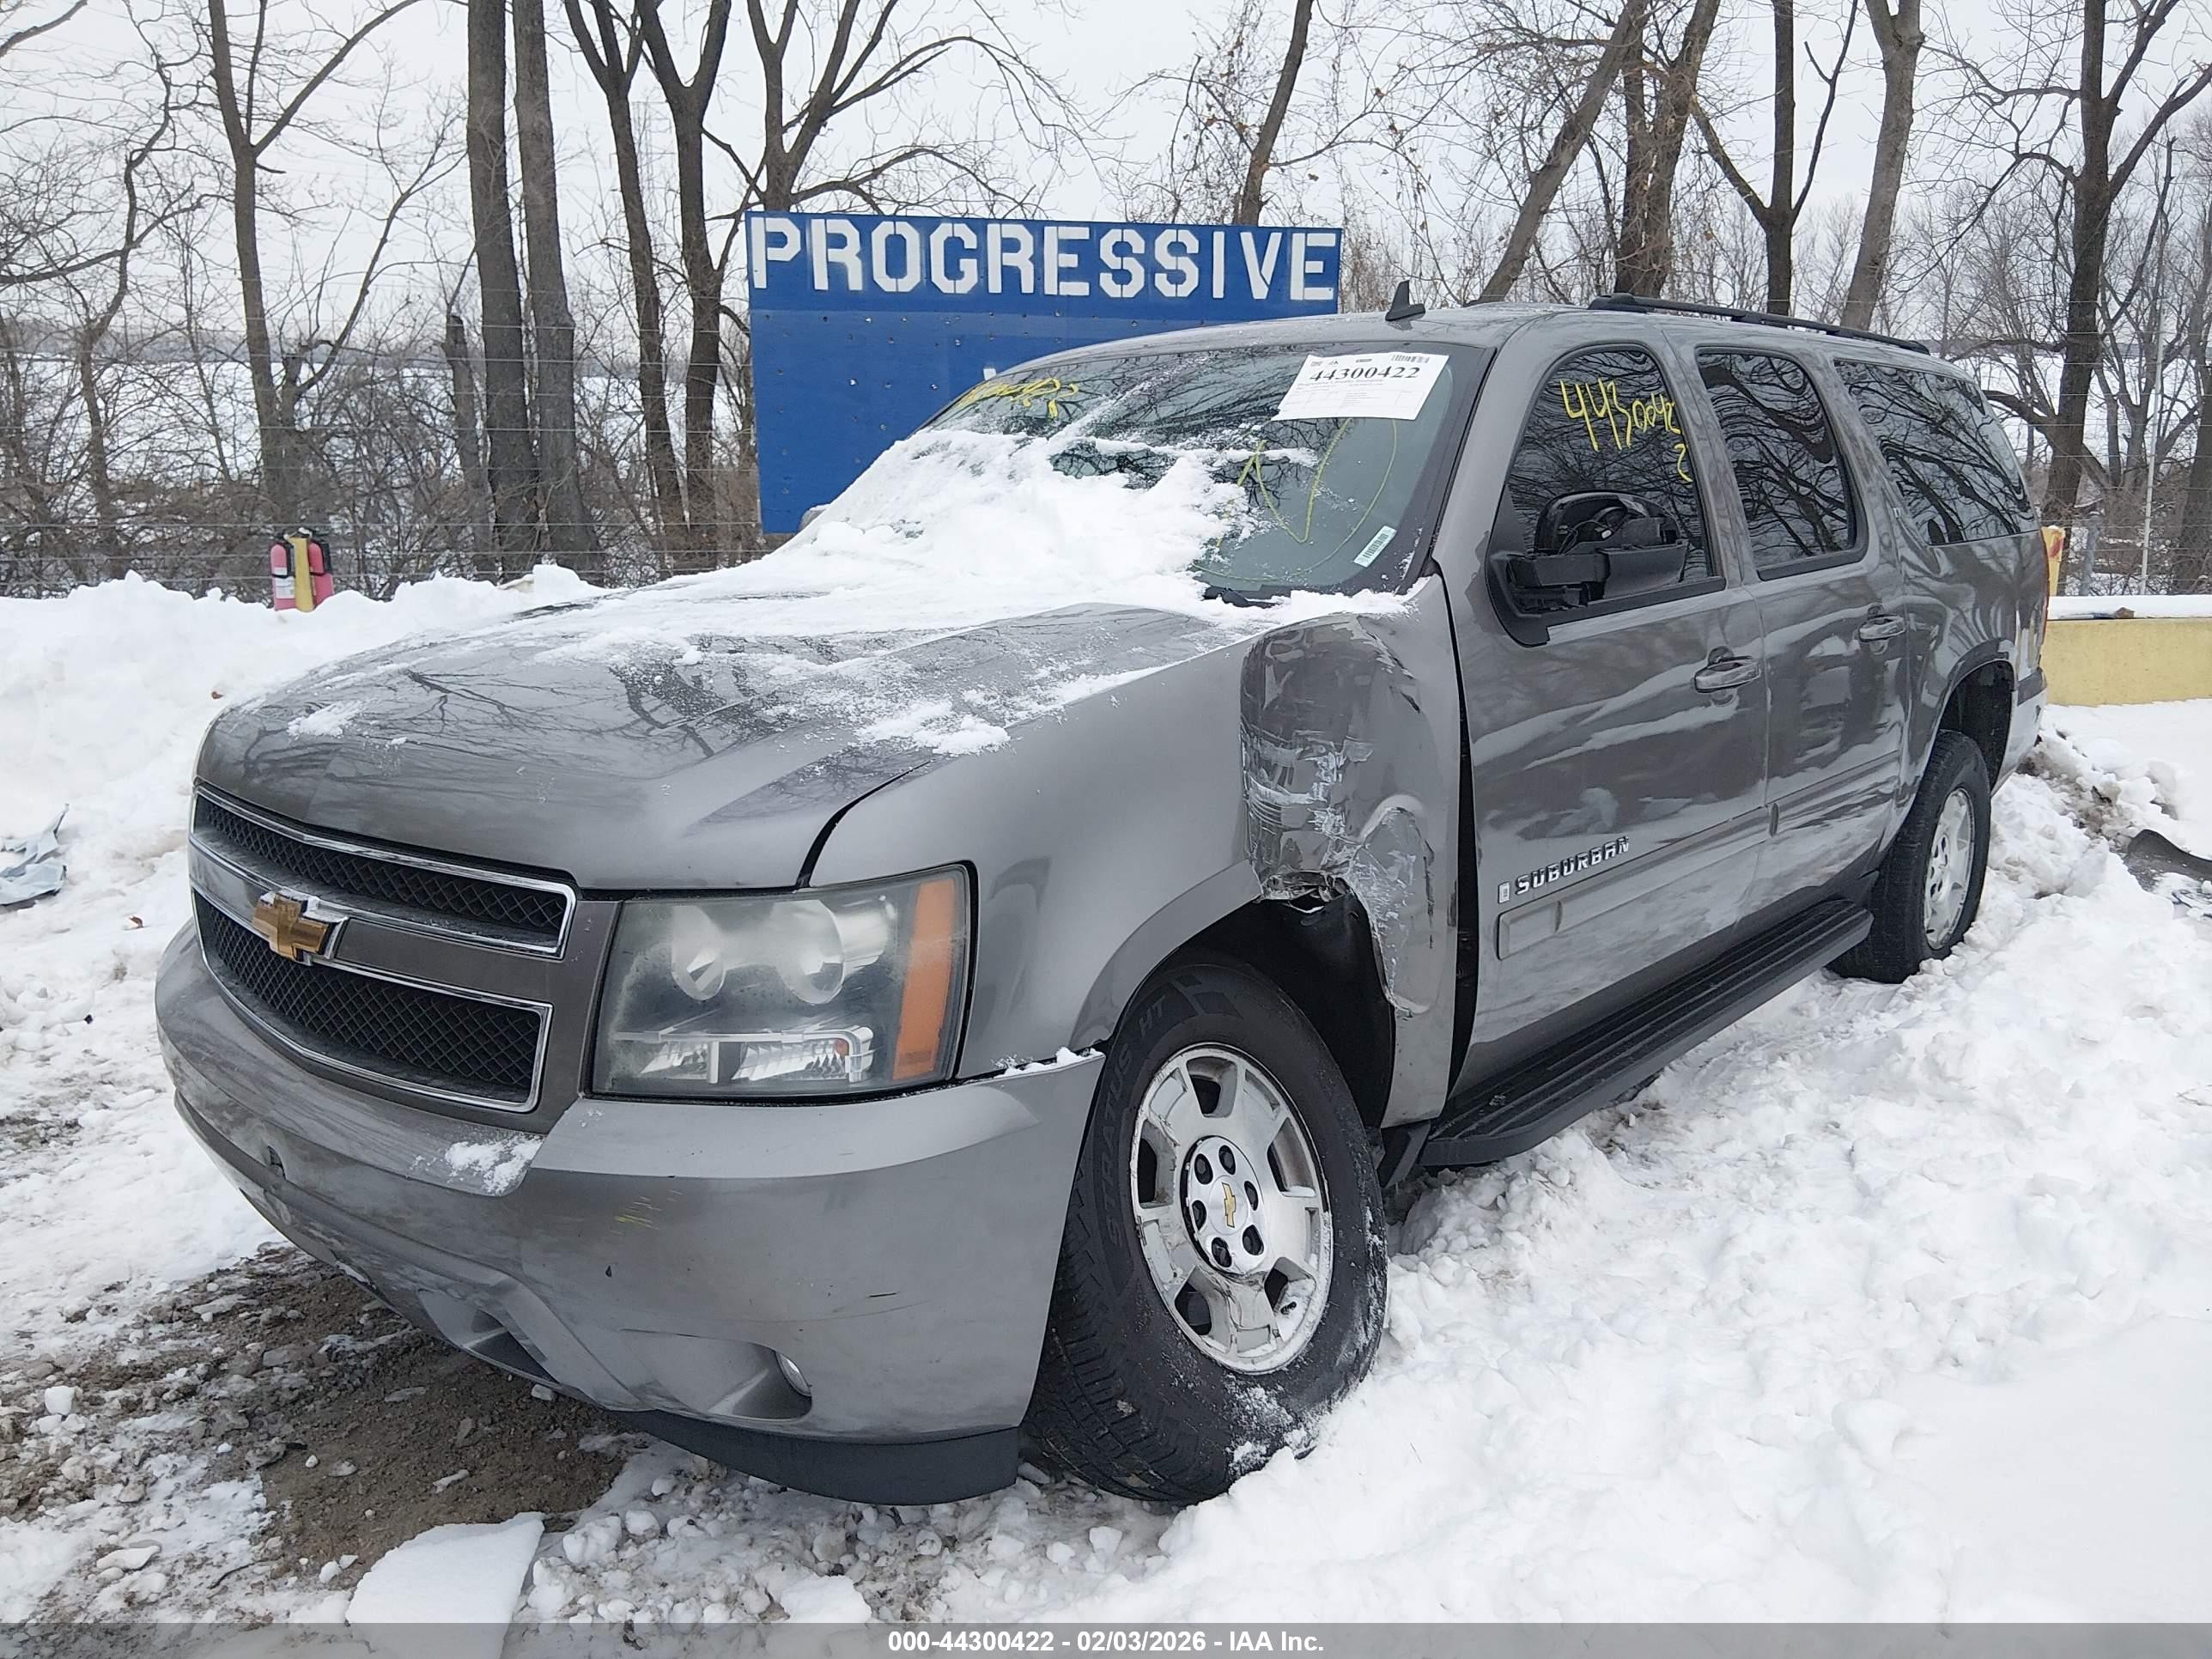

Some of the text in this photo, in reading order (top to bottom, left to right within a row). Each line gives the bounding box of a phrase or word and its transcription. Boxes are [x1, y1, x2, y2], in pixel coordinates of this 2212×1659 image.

[750, 216, 1337, 301] PROGRESSIVE
[1310, 366, 1420, 381] 44300422
[1515, 836, 1630, 895] SUBURBAN
[1101, 1043, 1133, 1245] STRATUS
